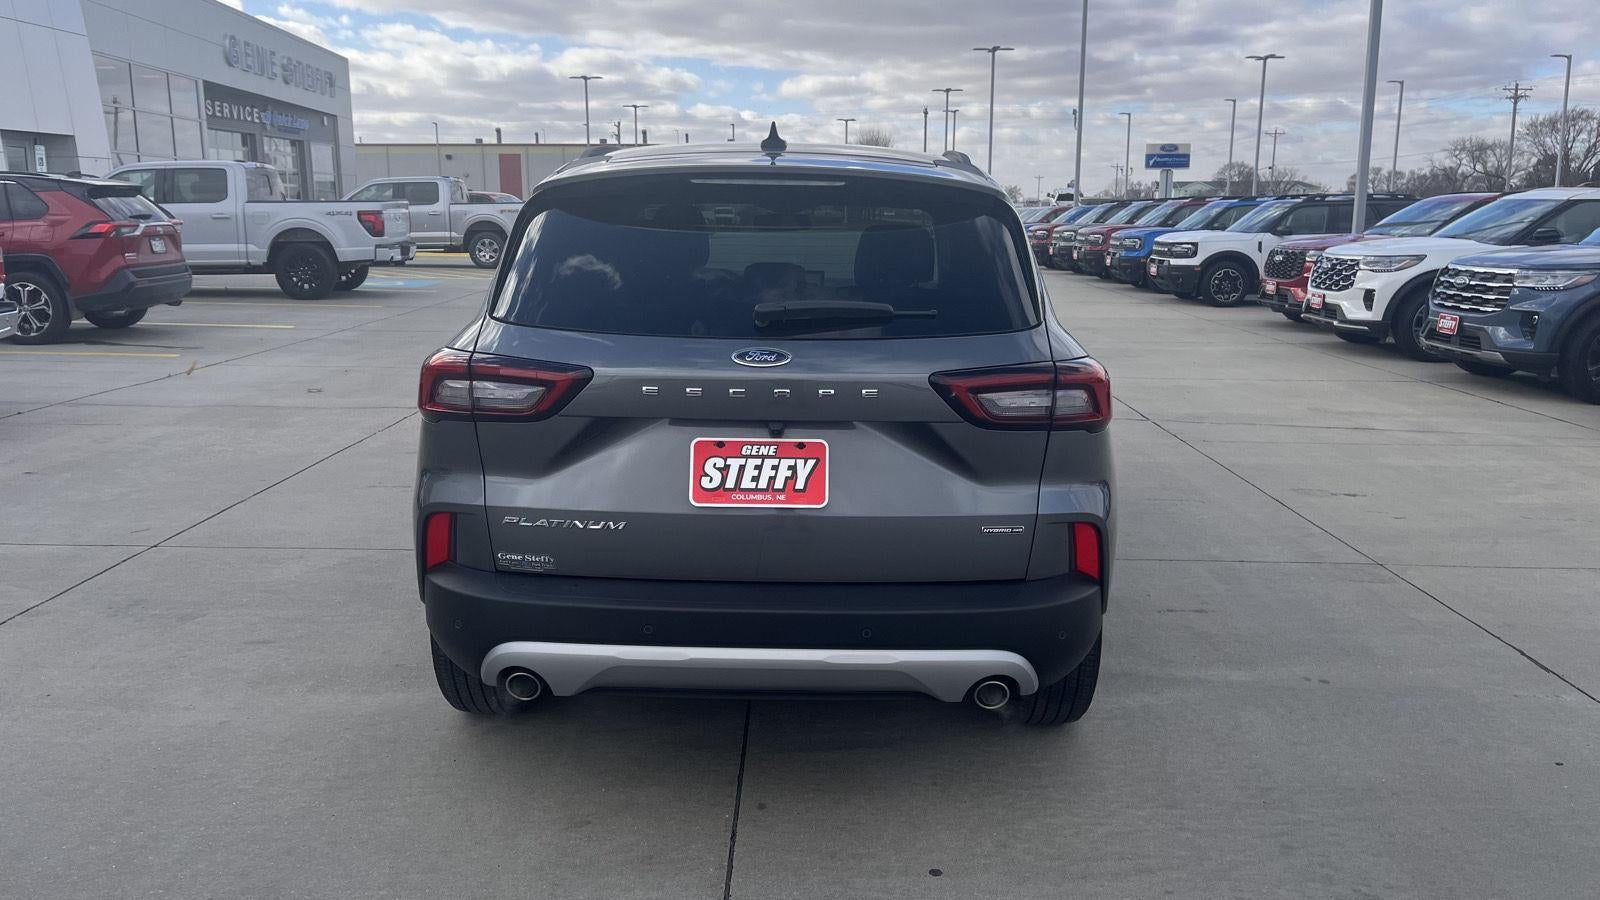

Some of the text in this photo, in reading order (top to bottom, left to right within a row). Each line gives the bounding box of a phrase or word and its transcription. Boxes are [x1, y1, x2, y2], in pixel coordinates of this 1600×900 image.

[205, 99, 260, 123] SERVICE
[745, 350, 778, 362] Ford
[642, 386, 879, 398] ESCAPE
[740, 444, 778, 456] GENE
[700, 456, 820, 492] STEFFY
[731, 493, 774, 501] COLUMBUS,
[502, 516, 627, 530] PLATINUM
[498, 552, 523, 561] Gene
[524, 554, 555, 564] Steffy
